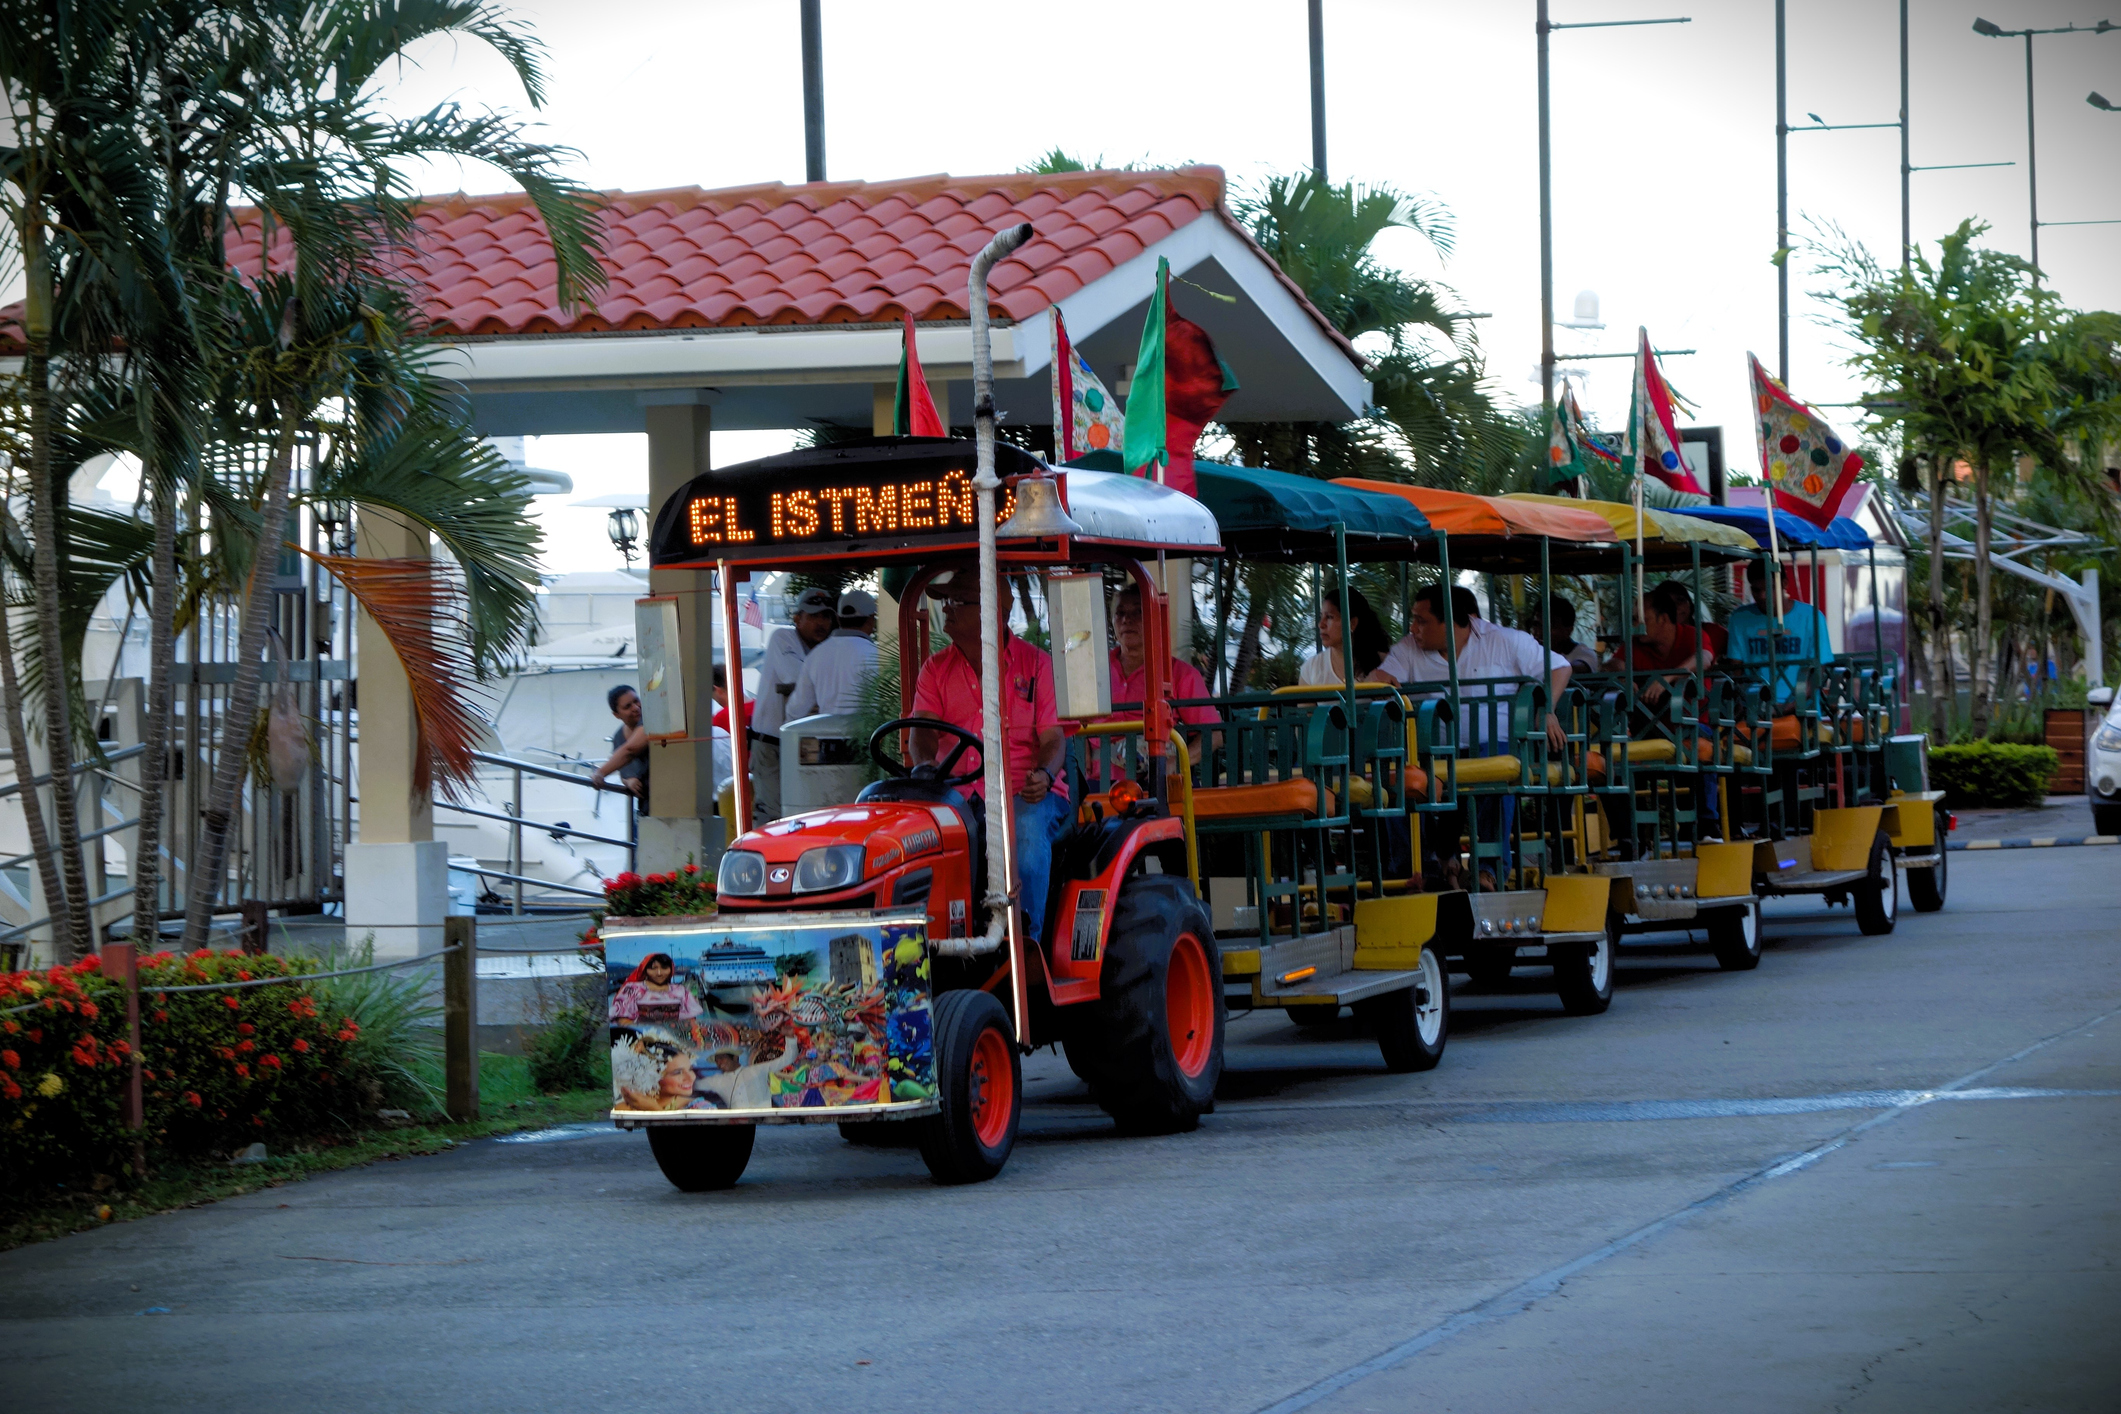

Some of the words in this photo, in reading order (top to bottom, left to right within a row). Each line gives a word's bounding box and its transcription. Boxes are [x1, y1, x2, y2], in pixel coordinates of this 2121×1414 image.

[690, 496, 756, 544] EL
[1748, 637, 1802, 655] STRNGER
[901, 829, 940, 855] KUBOTA
